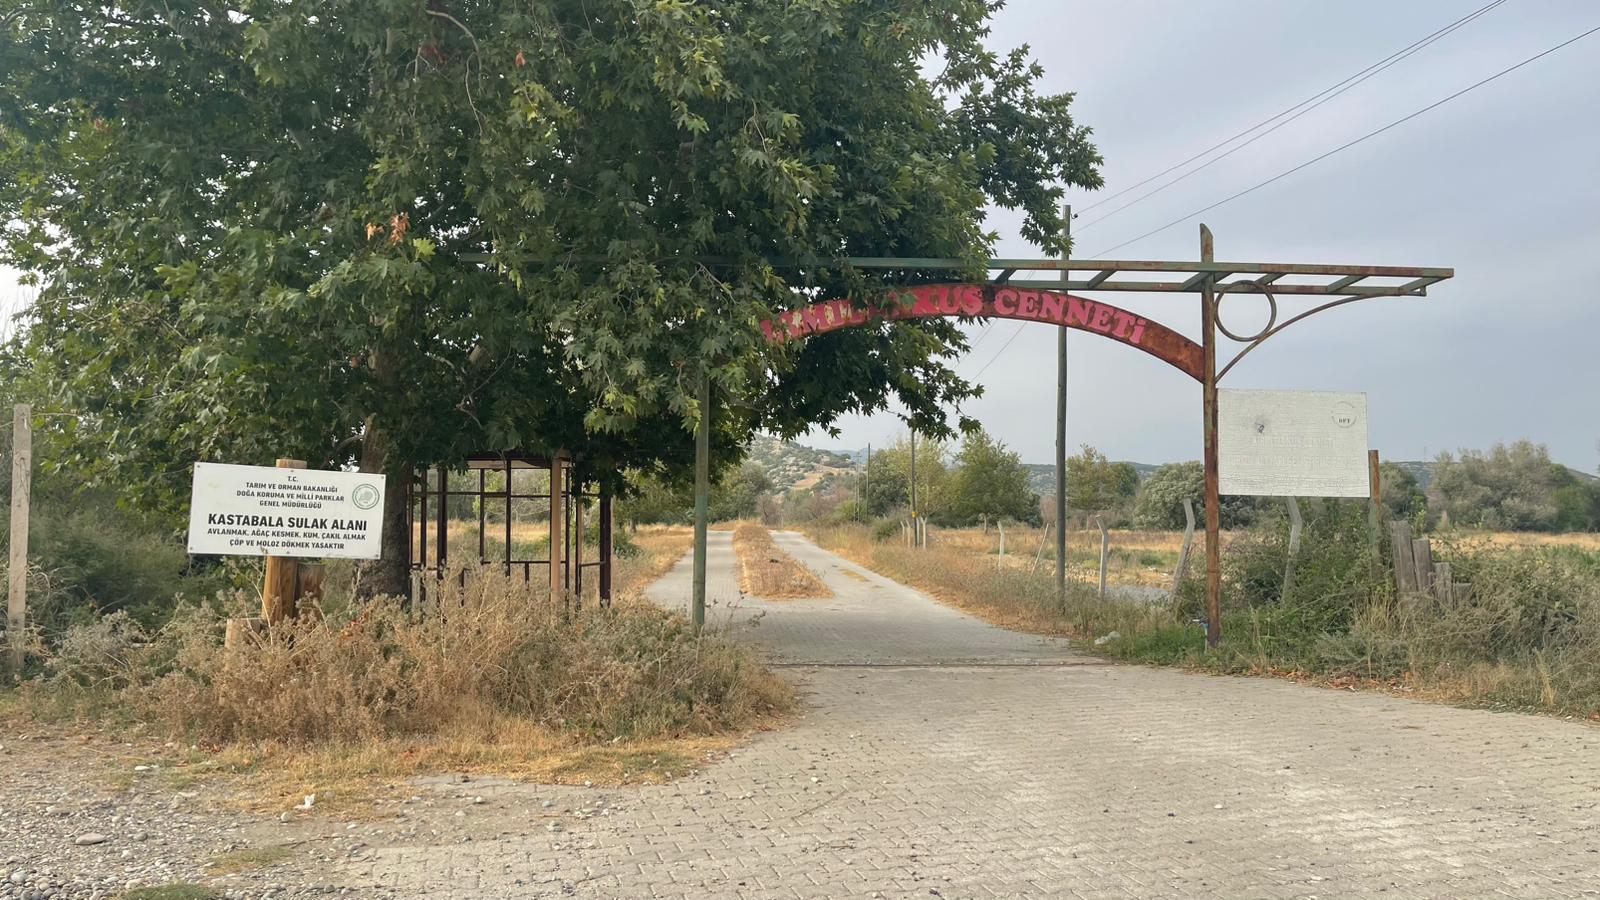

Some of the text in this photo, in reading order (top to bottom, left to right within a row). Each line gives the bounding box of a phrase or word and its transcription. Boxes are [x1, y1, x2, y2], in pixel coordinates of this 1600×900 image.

[278, 483, 301, 491] ORMAN
[208, 514, 367, 531] KASTABALA SULAK ALANI
[251, 528, 270, 537] AĞAÇ
